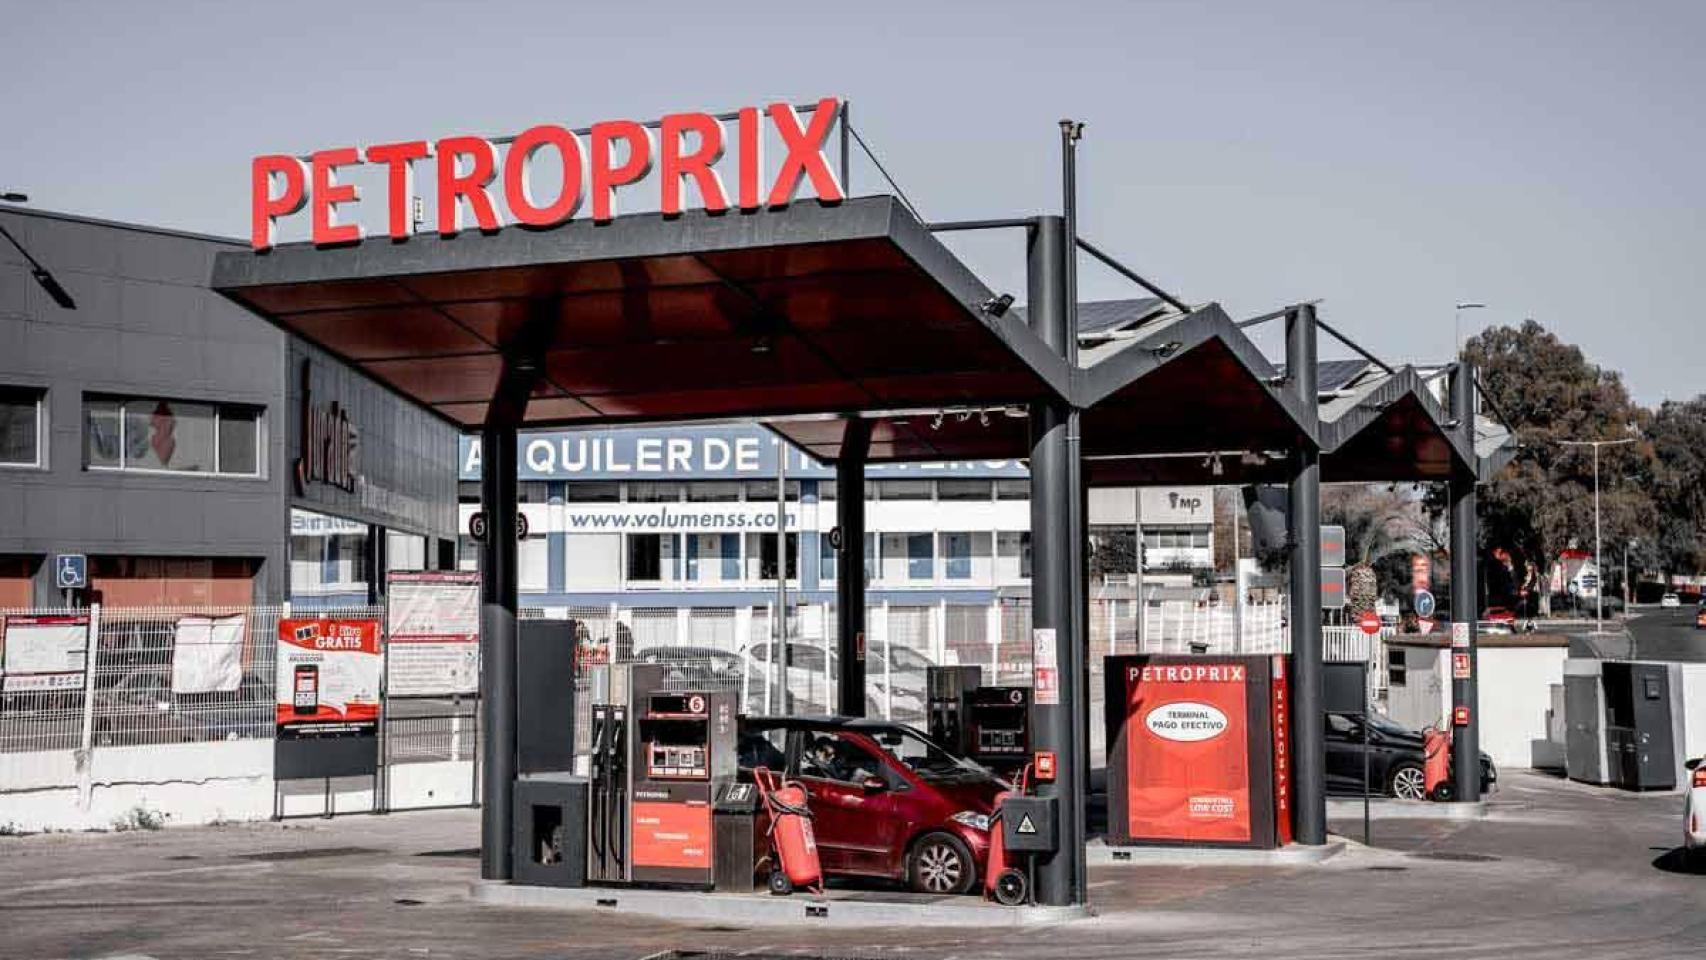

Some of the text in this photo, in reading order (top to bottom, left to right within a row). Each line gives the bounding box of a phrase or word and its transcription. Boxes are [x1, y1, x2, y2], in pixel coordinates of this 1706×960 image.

[251, 98, 845, 252] PETROPRIX
[466, 438, 692, 474] AQUILER
[703, 437, 759, 472] DE
[315, 636, 362, 648] GRATIS
[1130, 667, 1243, 681] PETROPRIX
[1167, 711, 1209, 719] TERMINAL
[1152, 721, 1224, 729] PAGO EFECTIVO
